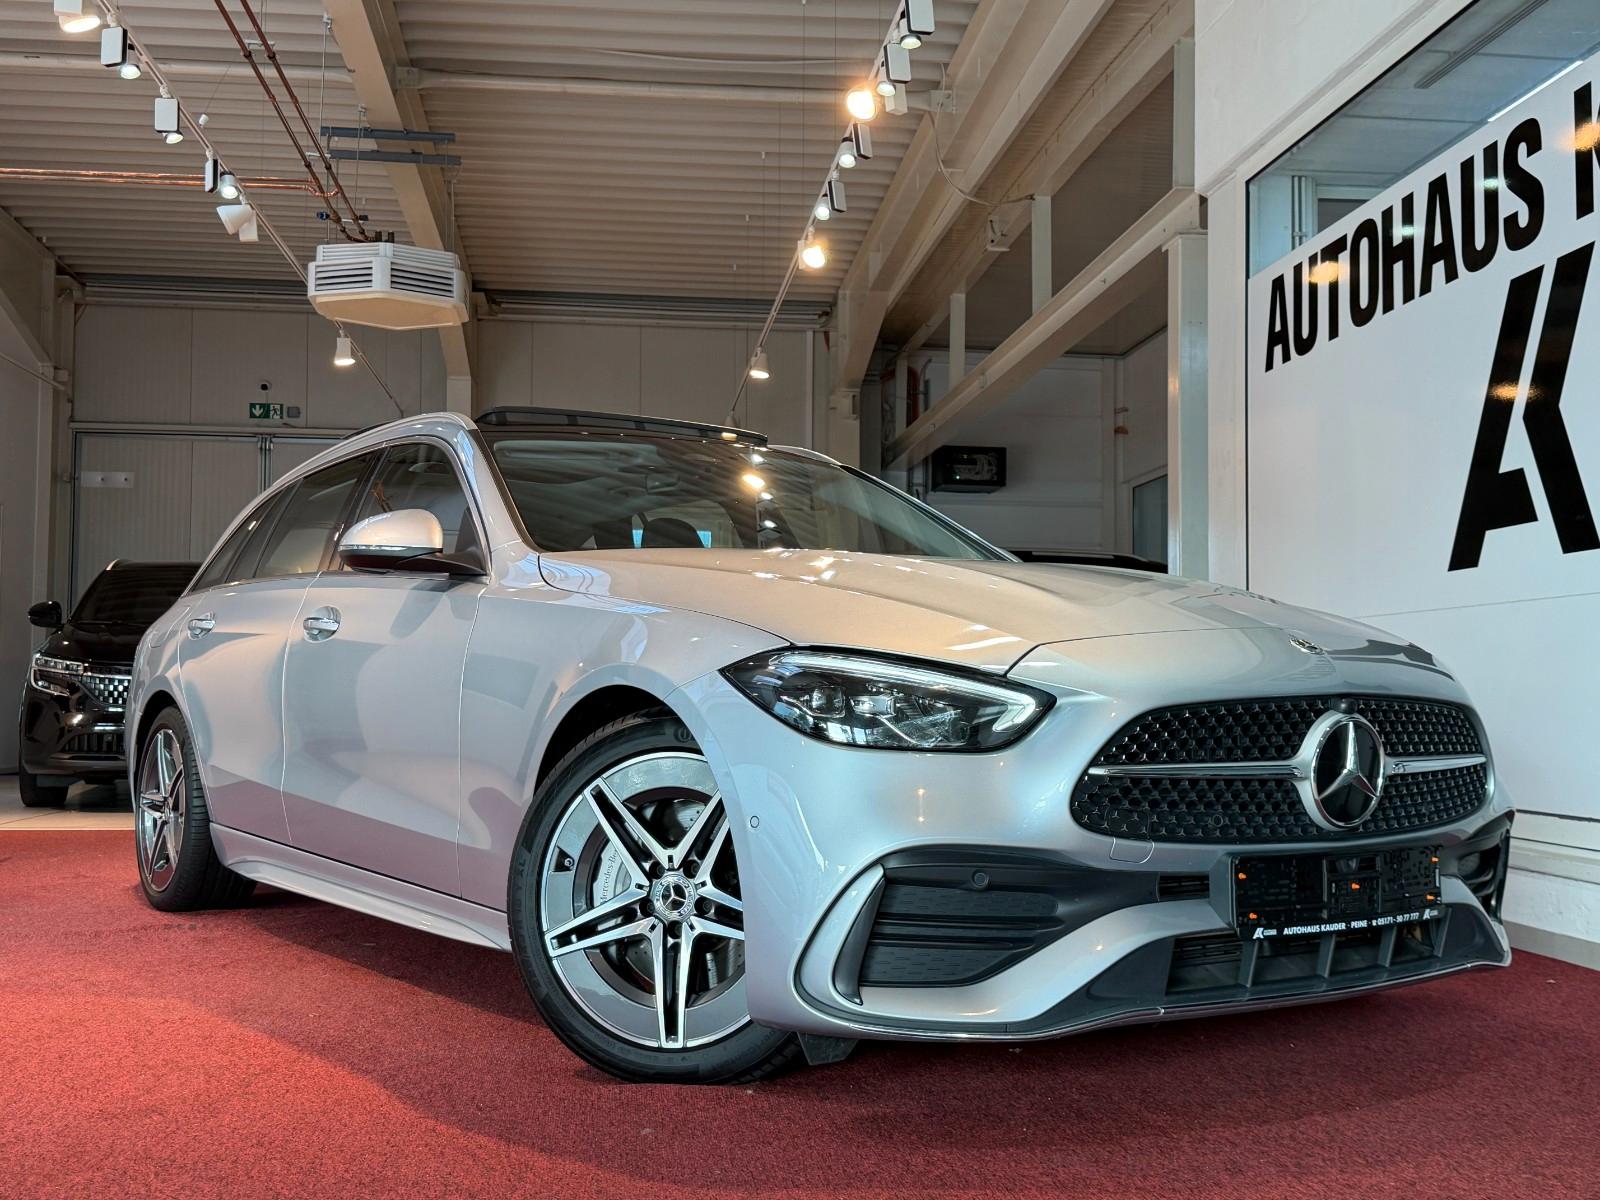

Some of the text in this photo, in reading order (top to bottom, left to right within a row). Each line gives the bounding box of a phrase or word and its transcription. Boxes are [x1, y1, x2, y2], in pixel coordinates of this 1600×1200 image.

[1265, 118, 1545, 373] AUTOHAUS
[1282, 924, 1320, 936] AUTOHAUS
[1320, 922, 1347, 932] KAUDER
[1350, 919, 1368, 929] PEINE
